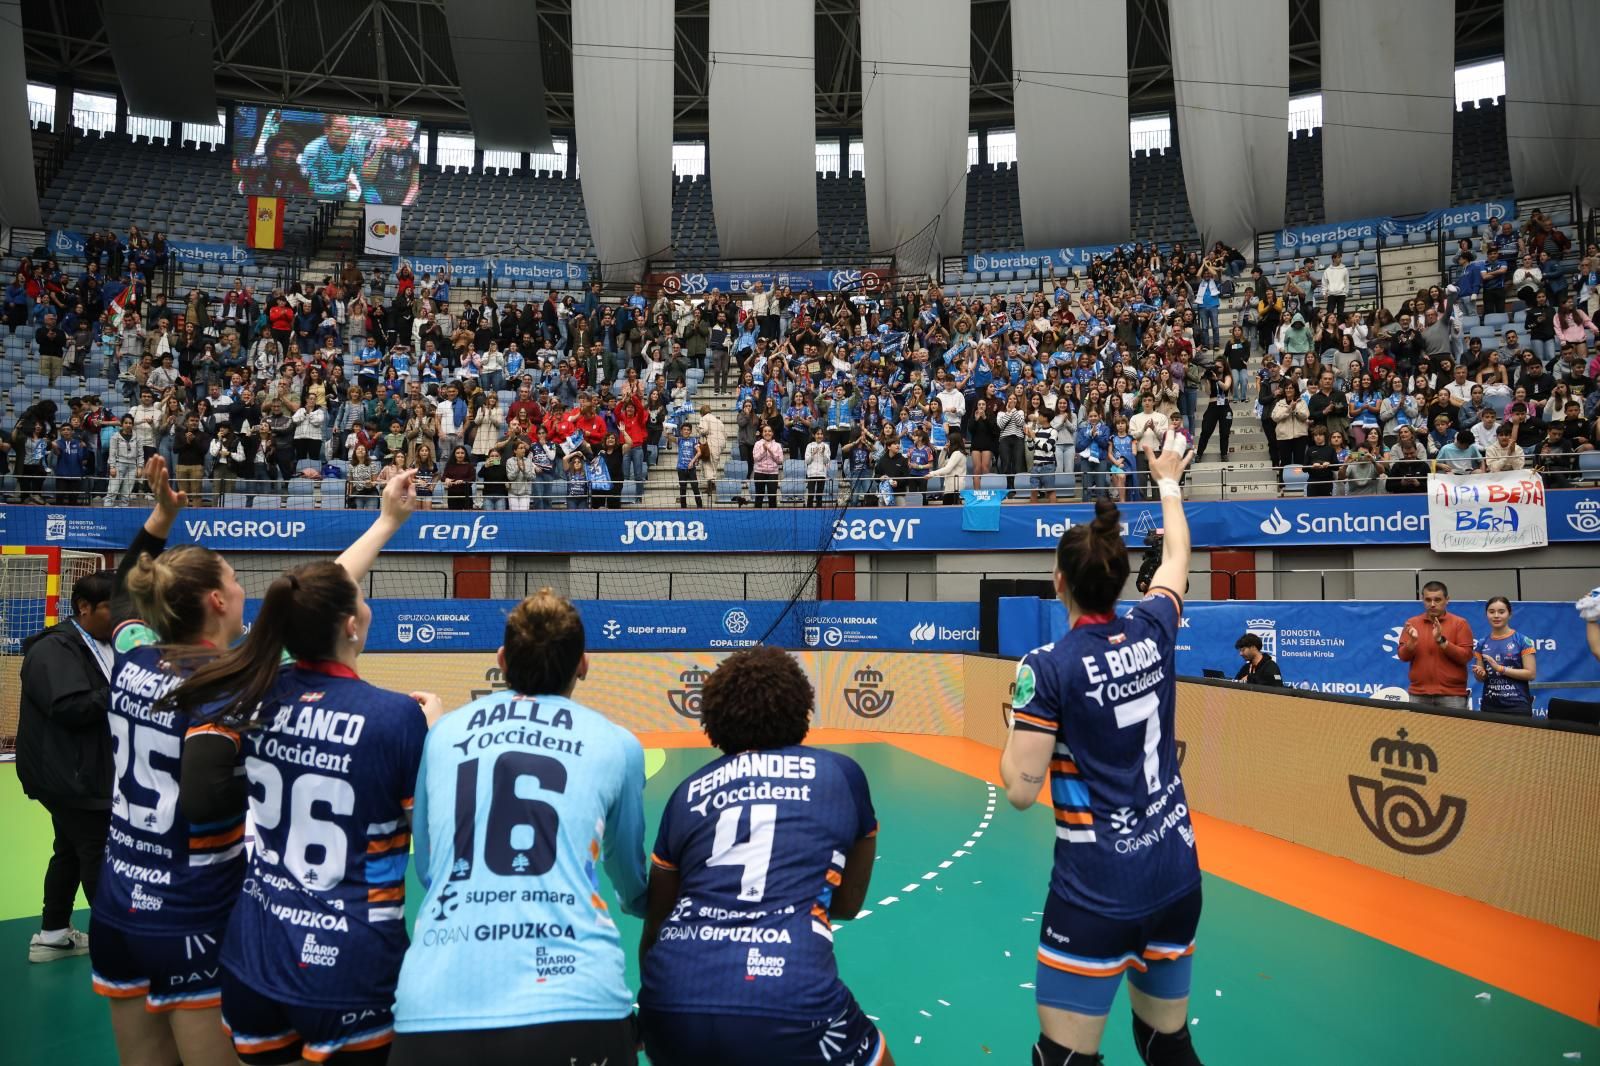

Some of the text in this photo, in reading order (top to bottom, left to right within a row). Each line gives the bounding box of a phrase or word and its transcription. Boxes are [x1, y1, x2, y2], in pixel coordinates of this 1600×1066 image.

[1302, 224, 1371, 245] berabera
[504, 262, 563, 278] berabera
[1036, 518, 1129, 538] hela
[1296, 510, 1429, 533] Santander
[1456, 506, 1519, 532] BERA
[185, 520, 306, 542] VARGROUP
[418, 515, 499, 548] renfe
[832, 518, 921, 543] sacyr
[436, 614, 470, 622] KIROLAK
[805, 616, 842, 624] GIPUZKOA
[627, 626, 687, 635] super amara
[938, 626, 980, 641] Iberdr
[1281, 629, 1321, 637] DONOSTIA
[710, 639, 733, 647] COPA
[1281, 637, 1345, 647] SAN SEBASTIÁN
[1081, 637, 1163, 685] E. BOADA
[1281, 650, 1335, 658] Donostia Kirola
[115, 661, 186, 700] ERAUSK
[466, 700, 574, 731] AALLA
[478, 725, 585, 757] Occident
[1113, 690, 1163, 796] 7
[265, 738, 352, 773] Occident
[107, 711, 180, 835] 25
[686, 753, 817, 804] FERNANDES
[712, 781, 812, 809] Occident
[244, 755, 356, 891] 26
[449, 750, 569, 882] 16
[705, 803, 777, 903] 4
[113, 858, 172, 885] IPUZKOA
[131, 899, 162, 911] VASCO
[465, 888, 576, 907] super amara
[305, 933, 317, 944] EL
[474, 922, 577, 941] GIPUZKOA
[699, 925, 792, 944] GIPUZKOA
[302, 942, 340, 957] DIARIO
[536, 946, 549, 956] EL
[748, 947, 761, 957] EL
[301, 952, 337, 967] VASCO
[536, 954, 577, 967] DIARIO
[747, 956, 786, 968] DIARIO
[536, 965, 576, 977] VASCO
[746, 965, 784, 977] VASCO
